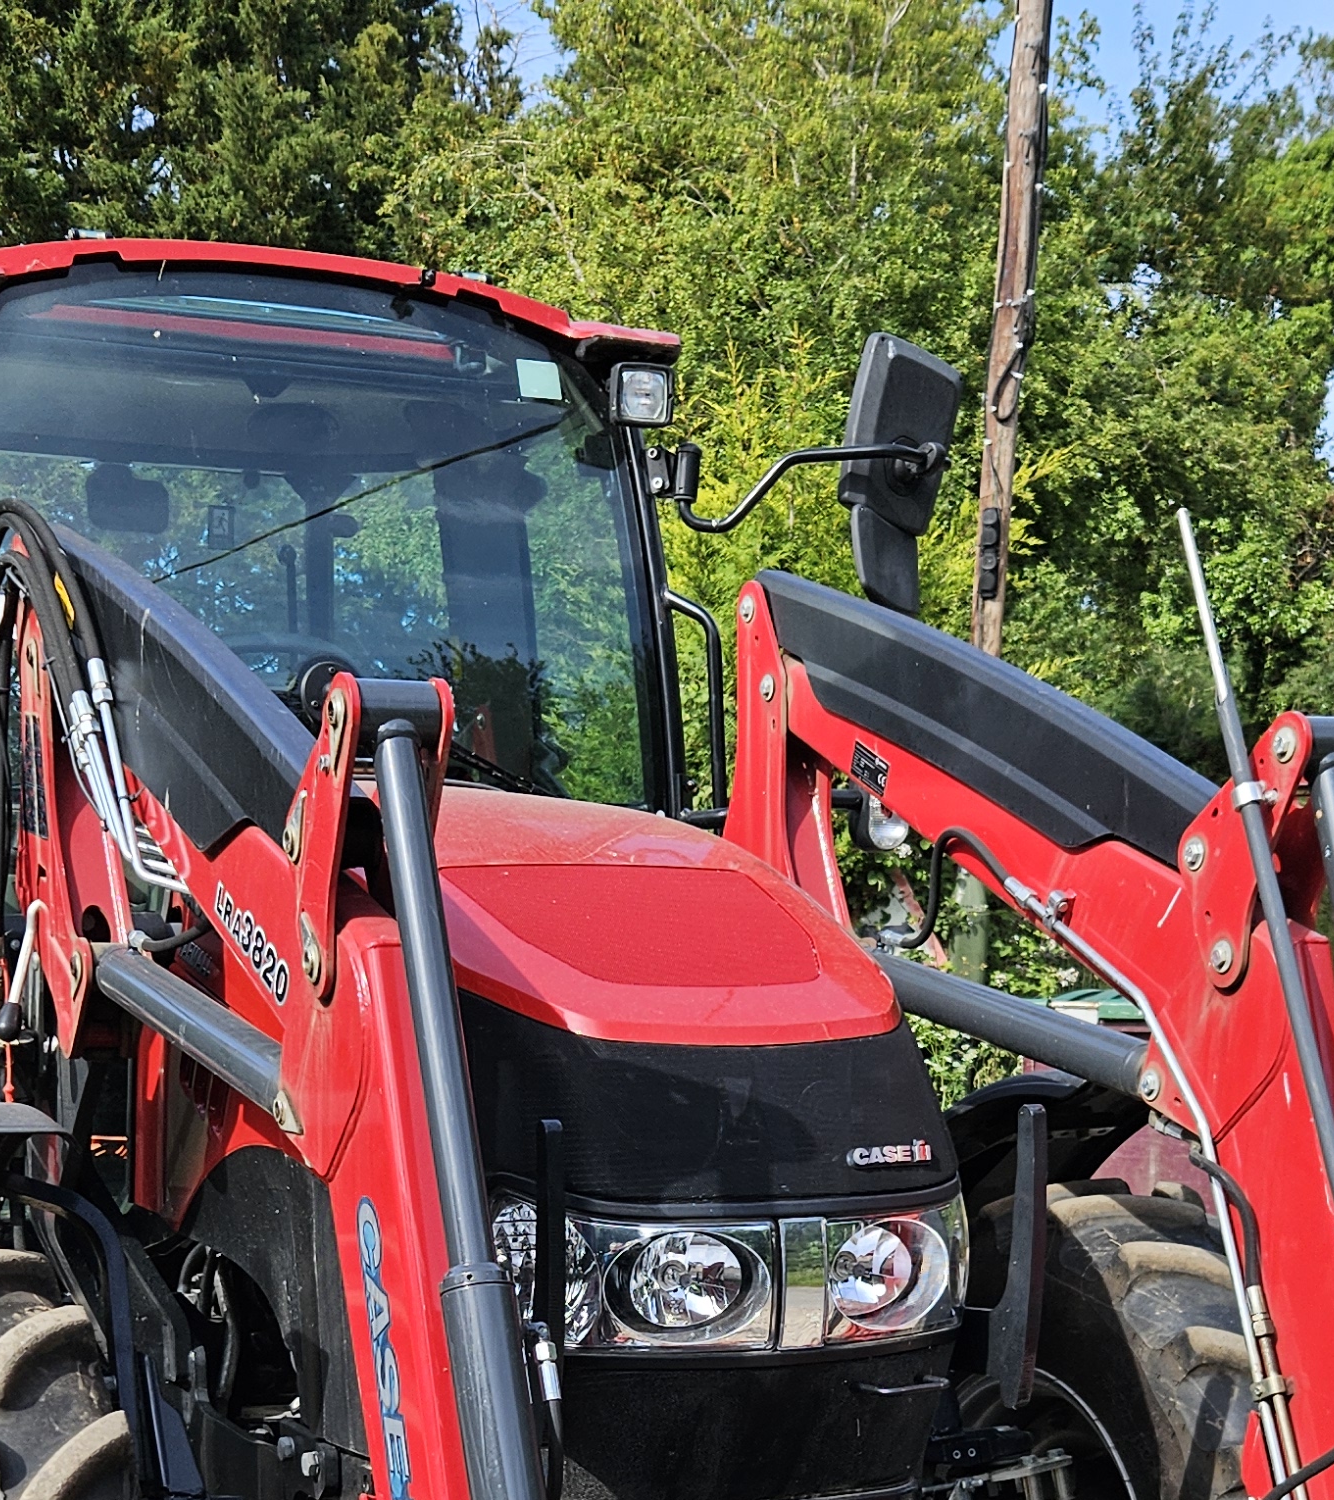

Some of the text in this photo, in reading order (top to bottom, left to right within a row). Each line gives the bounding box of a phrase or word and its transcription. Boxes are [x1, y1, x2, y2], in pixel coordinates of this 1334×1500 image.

[215, 880, 290, 1006] LRA3820
[852, 1144, 912, 1166] CASE
[357, 1196, 411, 1484] CASE
